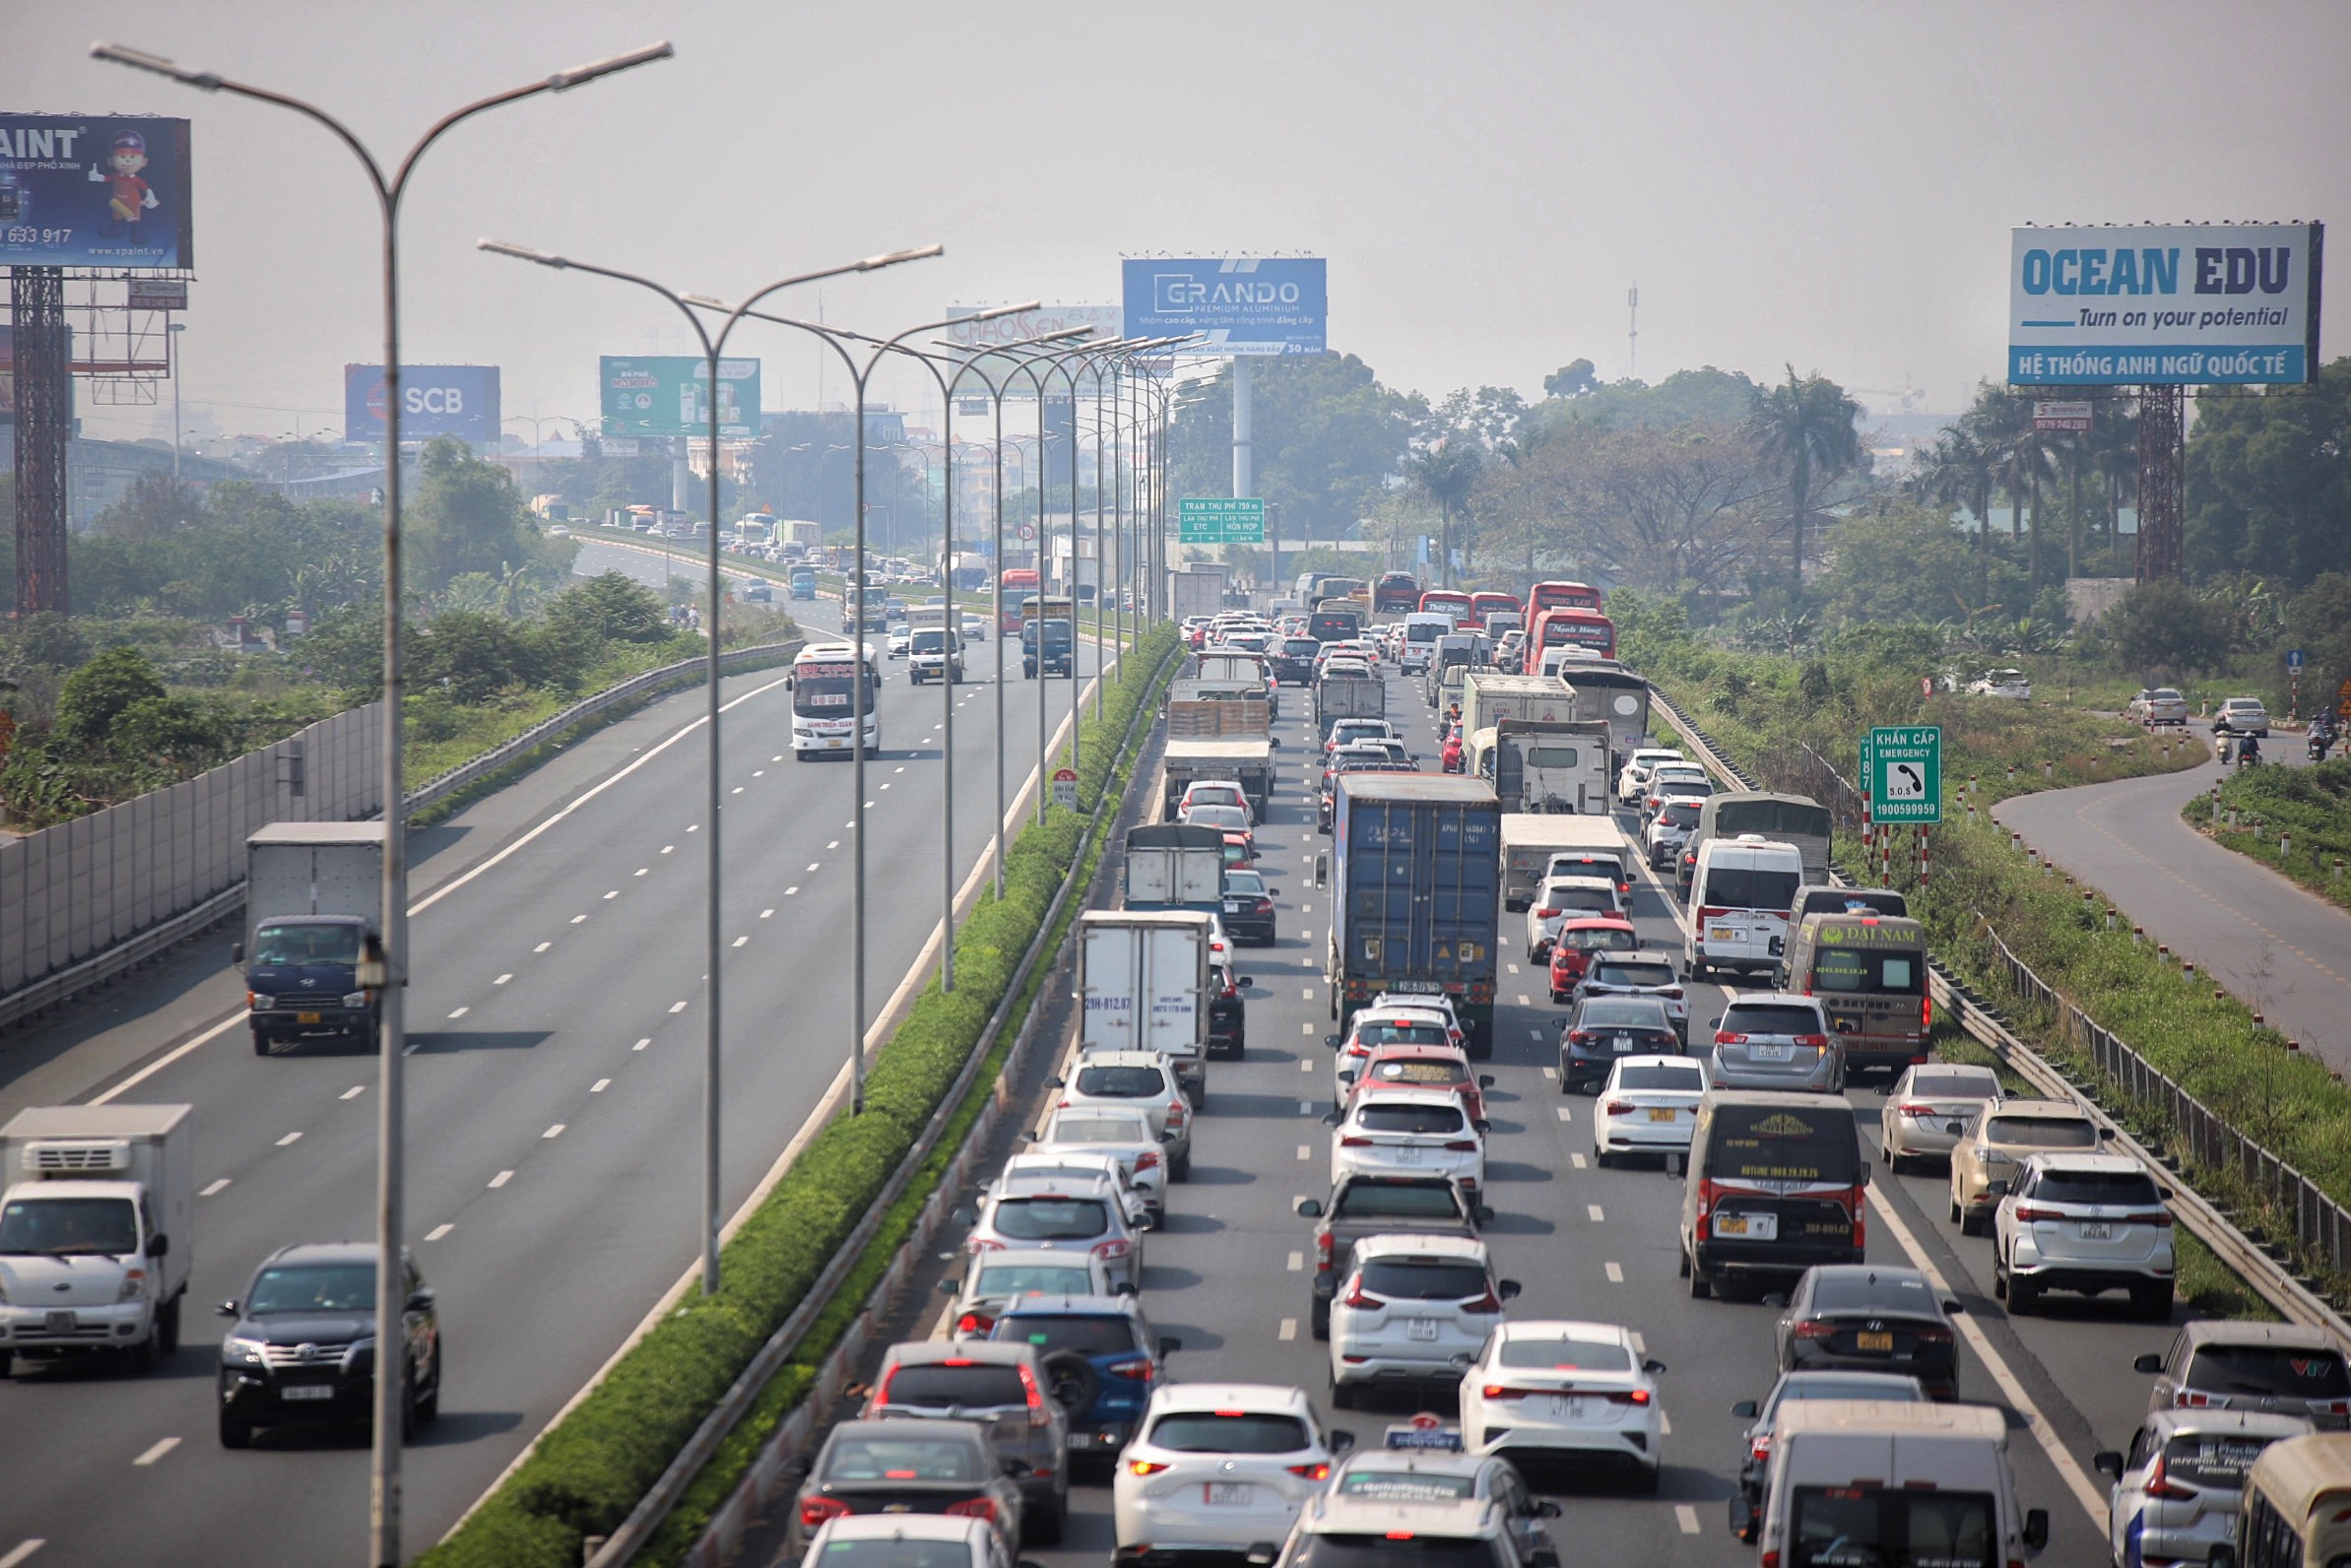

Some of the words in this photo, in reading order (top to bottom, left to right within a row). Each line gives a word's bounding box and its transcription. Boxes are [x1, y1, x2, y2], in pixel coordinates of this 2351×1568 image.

[8, 228, 37, 242] 633
[42, 229, 72, 243] 917
[2022, 248, 2180, 295] OCEAN
[2194, 247, 2291, 294] EDU
[1167, 282, 1300, 303] GRANDO
[2079, 308, 2117, 326] Turn
[2122, 311, 2147, 326] on
[2153, 311, 2197, 330] your
[2199, 307, 2289, 330] potential
[1287, 344, 1302, 354] 30
[2019, 353, 2044, 379] HỆ
[2048, 351, 2113, 375] THỐNG
[2117, 356, 2156, 374] ANH
[2162, 353, 2204, 375] NGỮ
[2207, 351, 2258, 376] QUỐC
[2263, 350, 2288, 374] TẾ
[406, 387, 463, 414] SCB
[1876, 729, 1907, 746] KHẨN
[1914, 729, 1935, 745] CẤP
[1879, 749, 1930, 758] EMERGENCY
[1889, 787, 1911, 796] S.O.S
[1876, 804, 1935, 816] 1900599959
[1881, 929, 1916, 944] NAM
